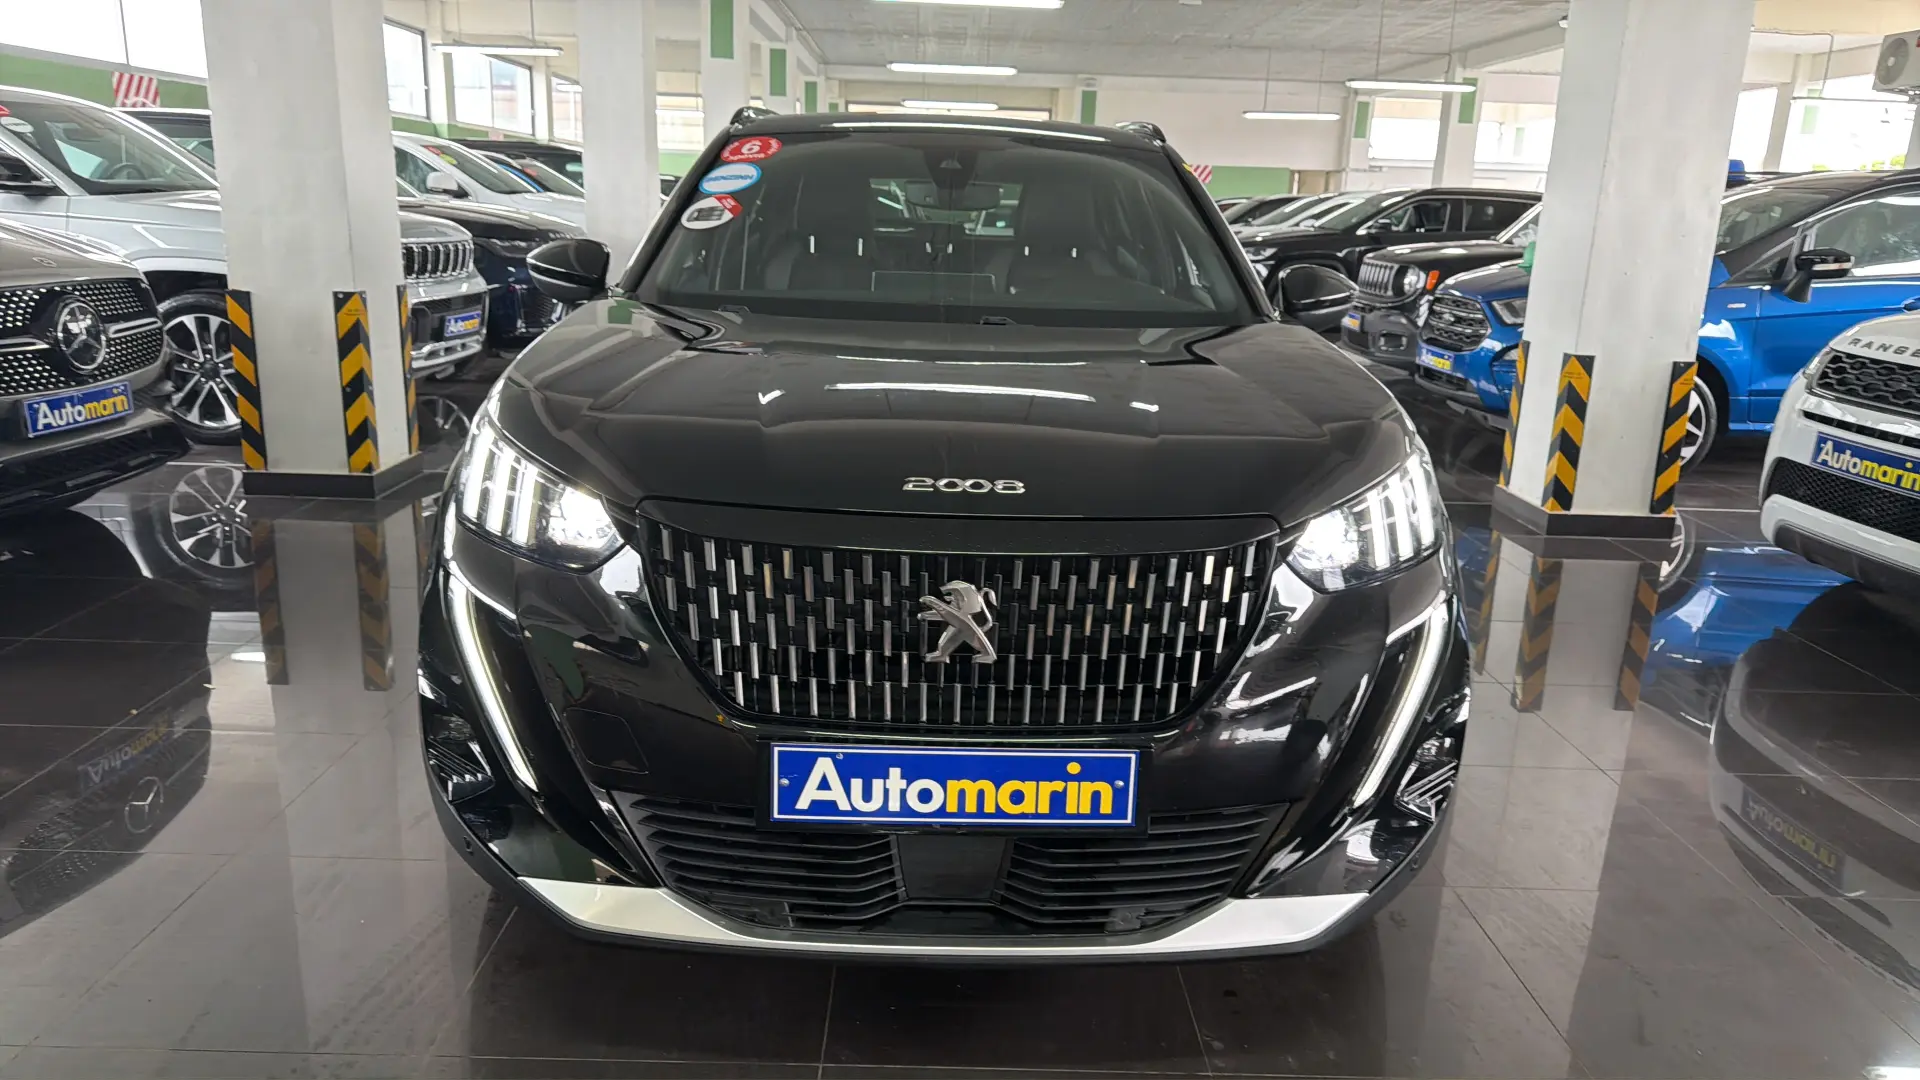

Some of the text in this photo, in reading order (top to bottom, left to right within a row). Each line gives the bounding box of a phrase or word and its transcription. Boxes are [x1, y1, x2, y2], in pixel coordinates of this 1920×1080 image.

[741, 140, 762, 154] 6
[37, 388, 129, 430] Automarin
[902, 476, 1026, 493] 2008
[795, 756, 1114, 814] Automarin
